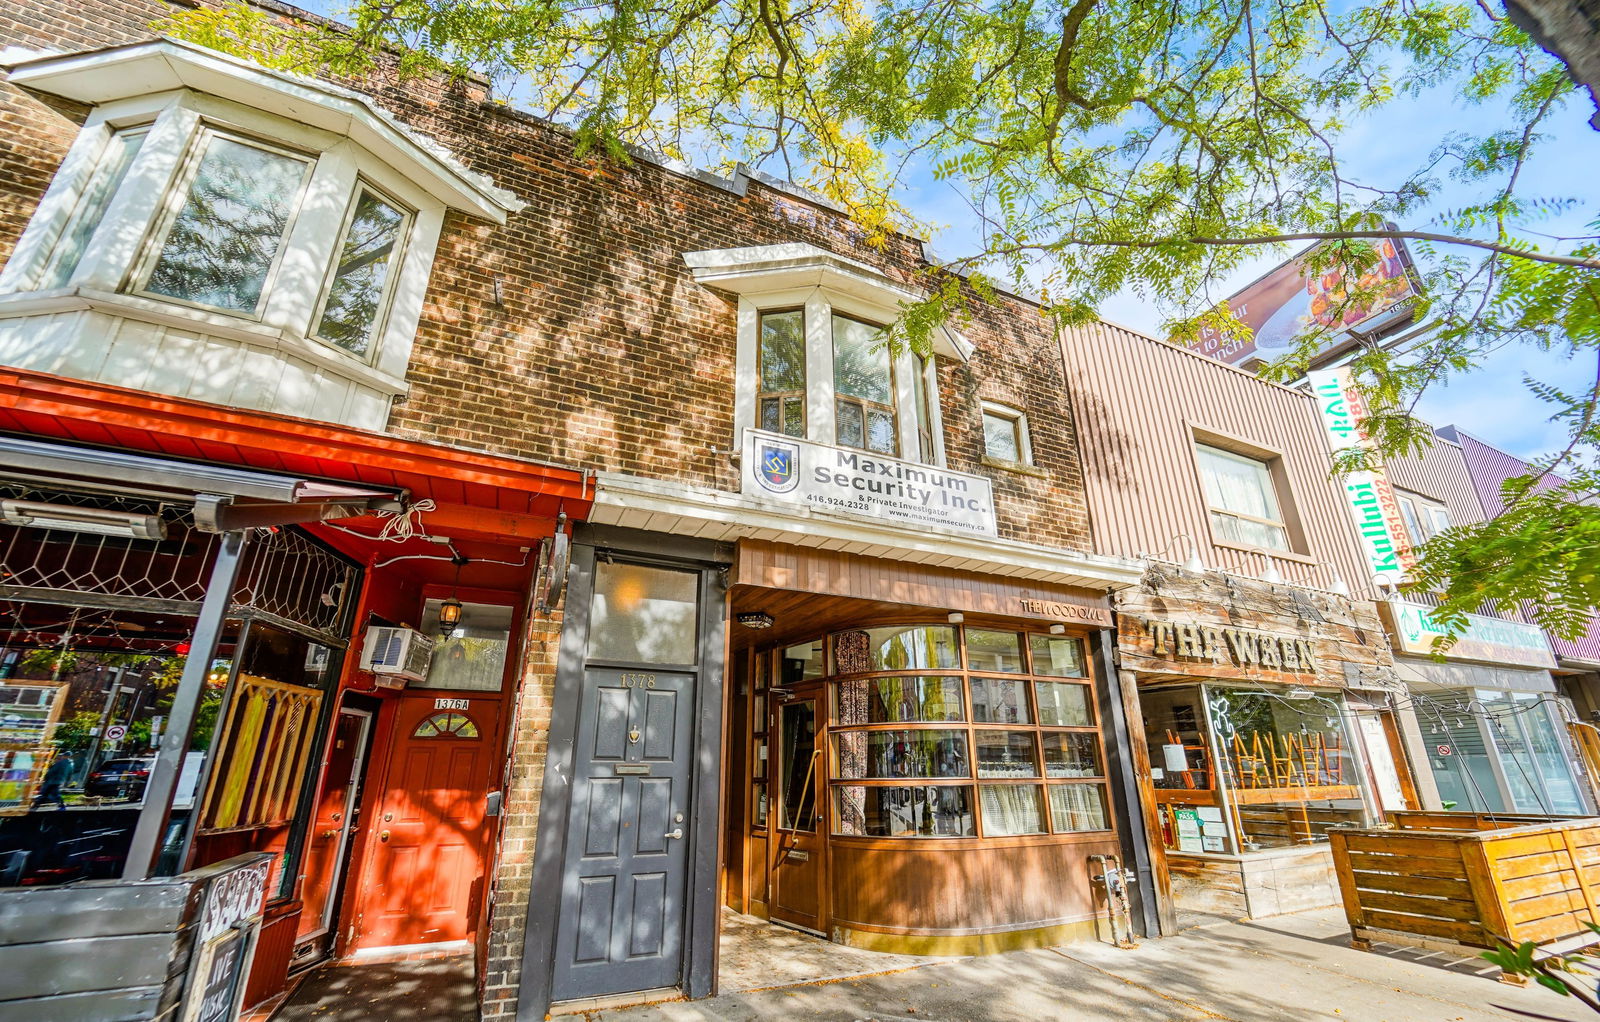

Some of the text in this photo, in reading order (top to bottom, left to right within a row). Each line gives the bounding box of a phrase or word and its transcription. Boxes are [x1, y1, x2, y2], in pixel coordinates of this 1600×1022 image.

[837, 451, 968, 492] Maximum
[815, 466, 931, 506] Security
[941, 490, 987, 513] Inc.
[806, 494, 869, 511] 416.924.2328
[867, 496, 898, 508] Private
[899, 501, 949, 517] Investigator
[889, 509, 985, 531] www.maximumsecurity.ca
[1347, 482, 1400, 572] Kullubi
[1020, 600, 1041, 614] THE
[1041, 602, 1077, 618] WOOD
[1148, 619, 1317, 670] THE WREN
[621, 673, 656, 689] 1378
[436, 699, 468, 709] 1376A
